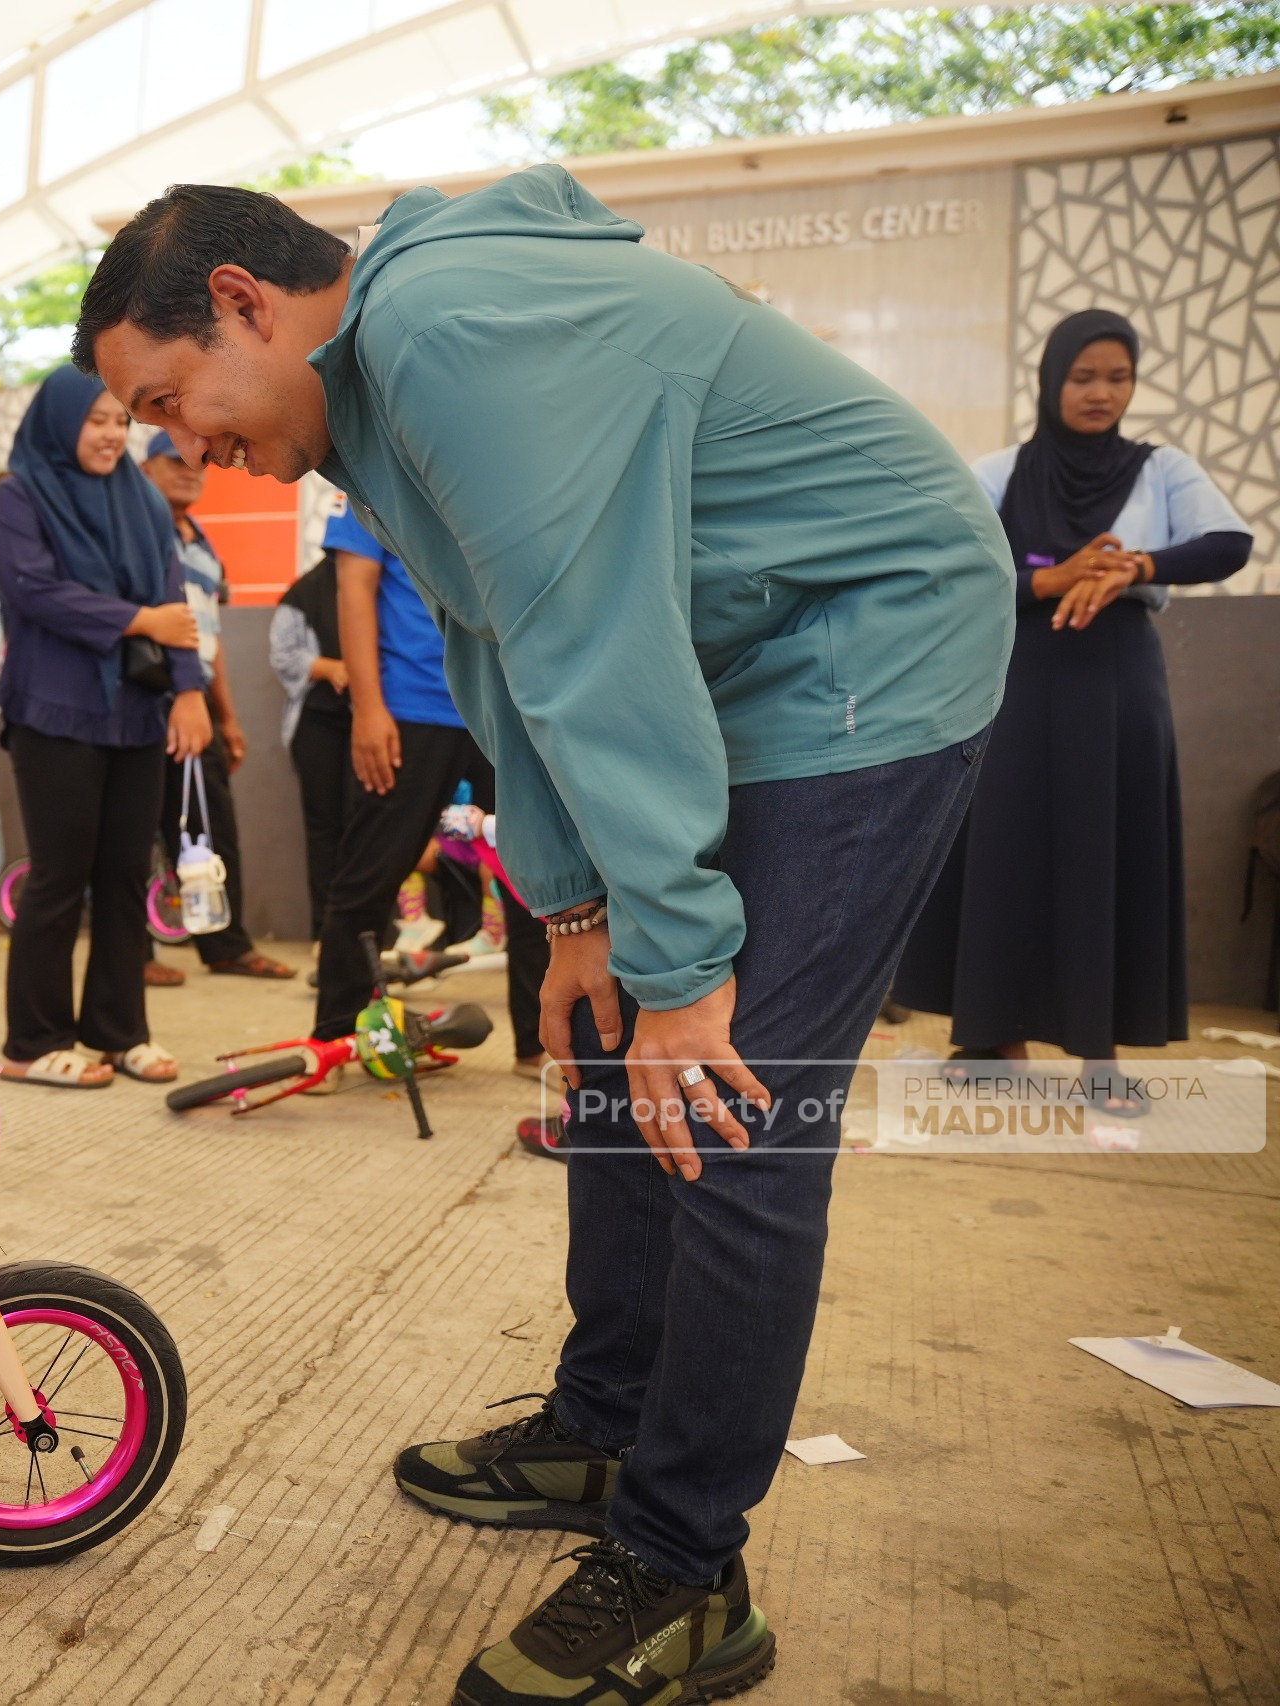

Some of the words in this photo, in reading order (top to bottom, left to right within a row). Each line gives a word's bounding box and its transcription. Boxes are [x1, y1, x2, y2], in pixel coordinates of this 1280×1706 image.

[707, 210, 851, 254] BUSINESS
[861, 198, 984, 242] CENTER
[644, 1616, 686, 1651] LACOSTE
